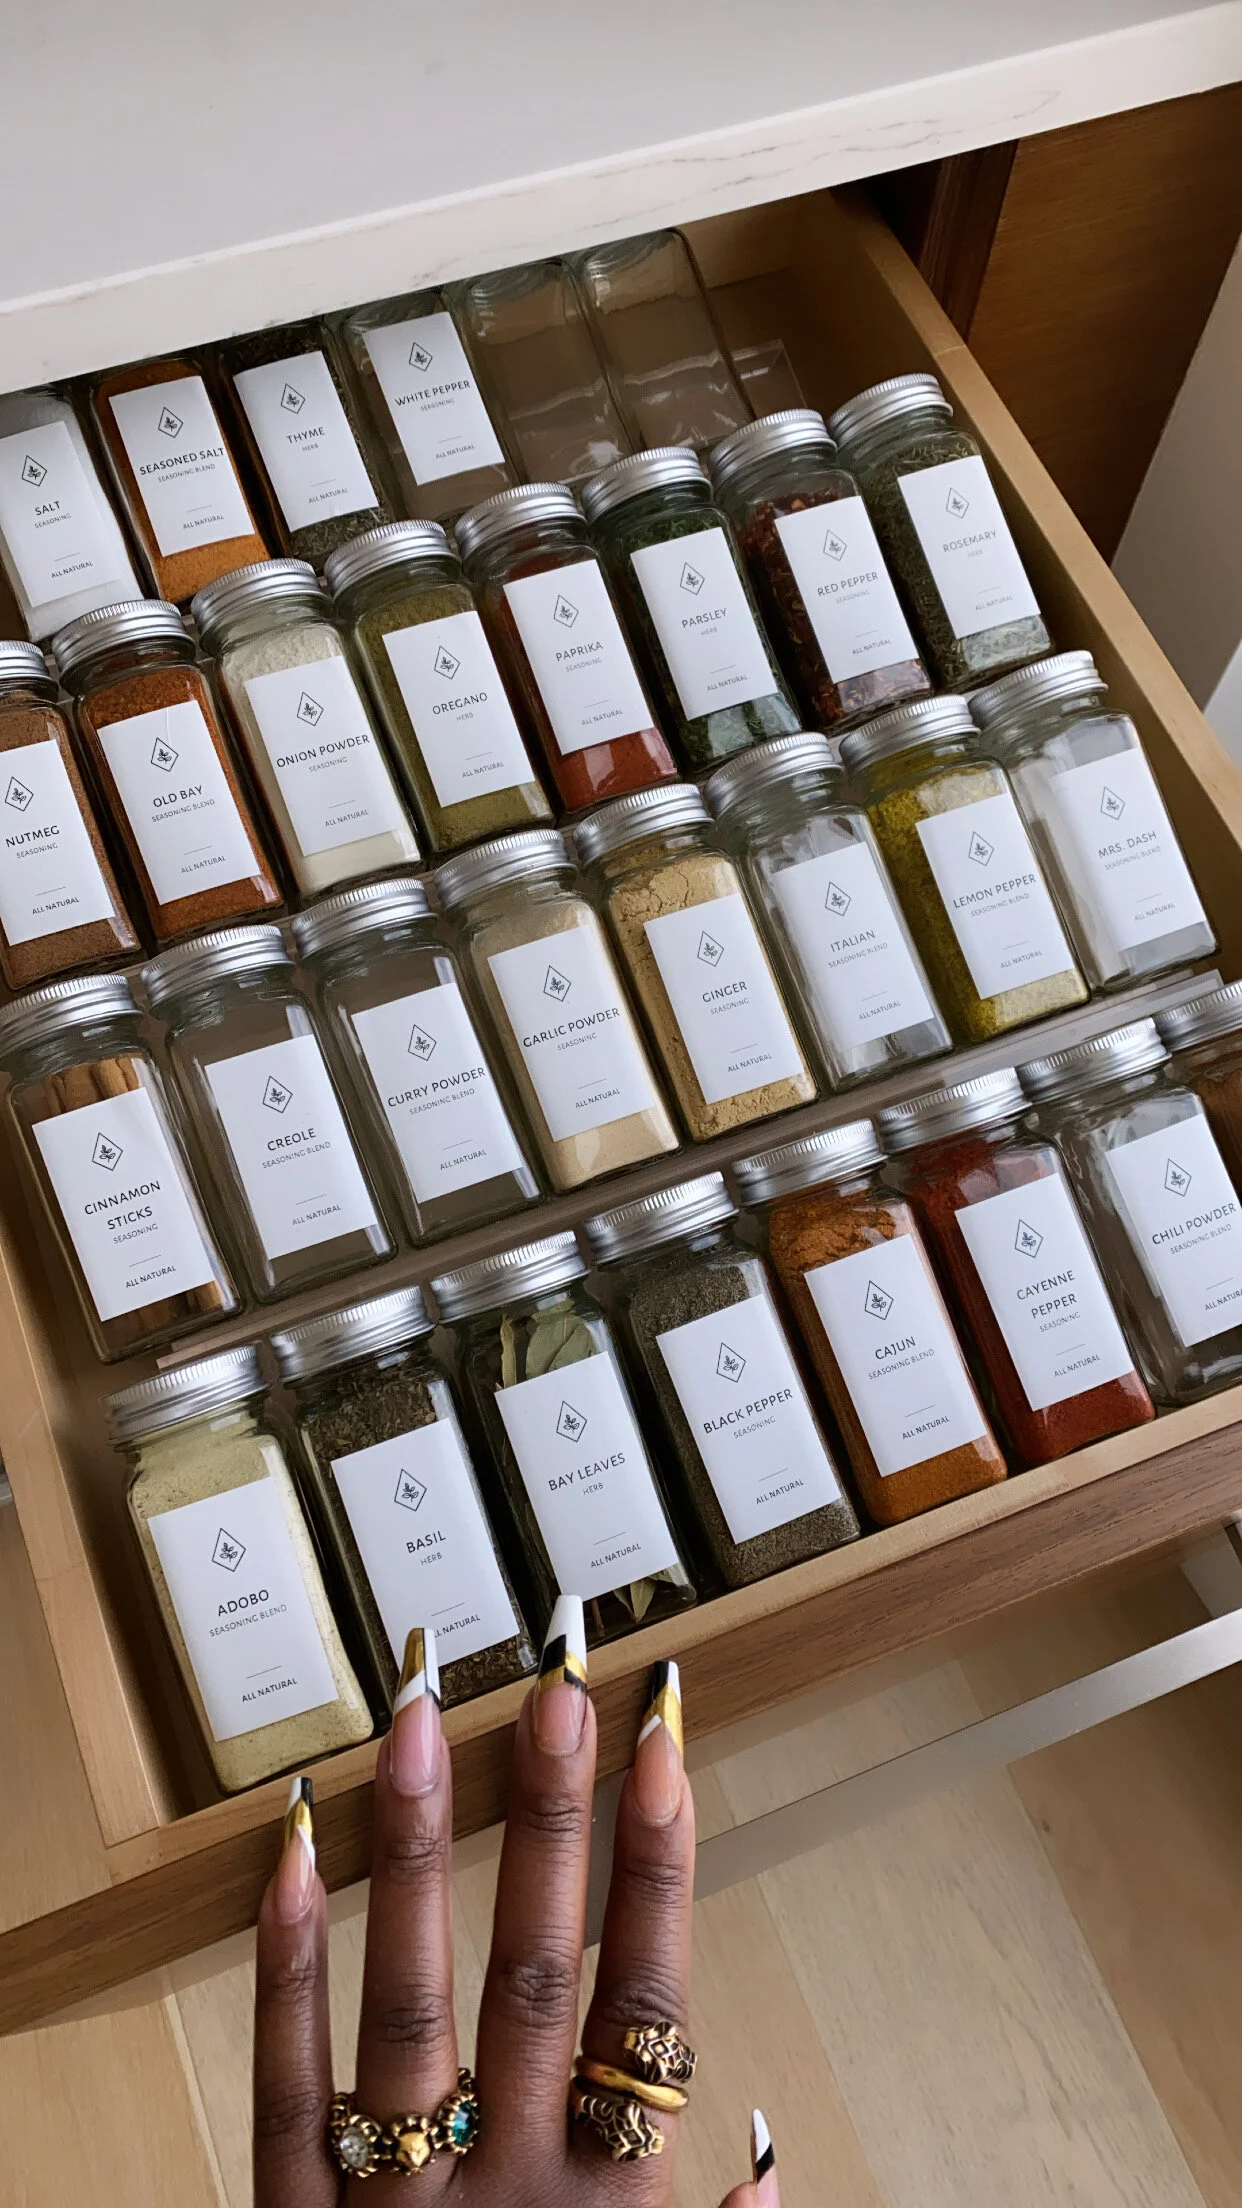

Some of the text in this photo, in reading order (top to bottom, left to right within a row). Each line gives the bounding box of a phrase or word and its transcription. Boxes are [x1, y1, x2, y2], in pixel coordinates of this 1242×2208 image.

[394, 380, 470, 406] WHITE PEPPER
[286, 426, 324, 443] THYME
[139, 447, 223, 476] SEASONED SALT
[435, 443, 475, 459] ALL NATURAL
[308, 487, 348, 503] ALL NATURAL
[34, 500, 59, 515] SALT
[34, 513, 71, 528] SEASONING
[183, 514, 224, 529] ALL NATURAL
[942, 529, 996, 552] ROSEMARY
[62, 561, 93, 574] NATURAL
[816, 571, 879, 596] RED PEPPER
[681, 607, 726, 628] PARSLEY
[555, 641, 603, 661] PAPRIKA
[706, 674, 748, 691] ALL NATURAL
[432, 692, 487, 714] OREGANO
[581, 709, 623, 725] ALL NATURAL
[276, 734, 369, 767] ONION POWDER
[308, 756, 347, 772] SEASONING
[473, 761, 504, 774] NATURAL
[152, 784, 201, 807] OLD BAY
[151, 798, 215, 822] SEASONING BLEND
[325, 809, 368, 826] ALL NATURAL
[5, 825, 59, 847] NUTMEG
[1098, 831, 1156, 858] MRS. DASH
[16, 842, 57, 858] SEASONING
[180, 855, 225, 873] ALL NATURAL
[952, 873, 1036, 908] LEMON PEPPER
[32, 896, 79, 914] ALL NATURAL
[830, 929, 875, 952] ITALIAN
[1000, 950, 1042, 968] ALL NATURAL
[702, 981, 747, 1002] GINGER
[709, 997, 749, 1014] SEASONING
[858, 999, 901, 1020] ALL NATURAL
[522, 1007, 619, 1047] GARLIC POWDER
[557, 1032, 596, 1050] SEASONING
[727, 1053, 772, 1072] ALL NATURAL
[387, 1067, 485, 1106] CURRY POWDER
[575, 1088, 620, 1108] ALL NATURAL
[409, 1087, 474, 1114] SEASONING BLEND
[267, 1127, 316, 1151] CREOLE
[261, 1141, 330, 1168] SEASONING BLEND
[440, 1149, 486, 1170] ALL NATURAL
[84, 1180, 160, 1214] CINNAMON
[107, 1205, 152, 1229] STICKS
[292, 1204, 341, 1225] ALL NATURAL
[1151, 1203, 1237, 1244] CHILI POWDER
[113, 1223, 158, 1244] SEASONING
[1170, 1223, 1231, 1254] SEASONING BLEND
[126, 1265, 176, 1288] ALL NATURAL
[1016, 1269, 1074, 1300] CAYENNE
[1031, 1293, 1076, 1318] PEPPER
[1204, 1301, 1217, 1310] ALL
[1039, 1311, 1080, 1332] SEASONING
[874, 1336, 915, 1359] CAJUN
[868, 1348, 934, 1379] SEASONING BLEND
[1054, 1354, 1100, 1377] ALL NATURAL
[703, 1388, 792, 1433] BLACK PEPPER
[733, 1415, 775, 1438] SEASONING
[902, 1415, 949, 1439] ALL NATURAL
[548, 1452, 625, 1490] BAY LEAVES
[583, 1482, 603, 1494] HERB
[756, 1480, 804, 1504] ALL NATURAL
[406, 1530, 446, 1553] BASIL
[420, 1551, 442, 1565] HERB
[590, 1543, 641, 1567] ALL NATURAL
[218, 1589, 269, 1616] ADOBO
[209, 1604, 286, 1637] SEASONING BLEND
[442, 1614, 480, 1634] NATURAL
[242, 1677, 297, 1702] ALL NATURAL
